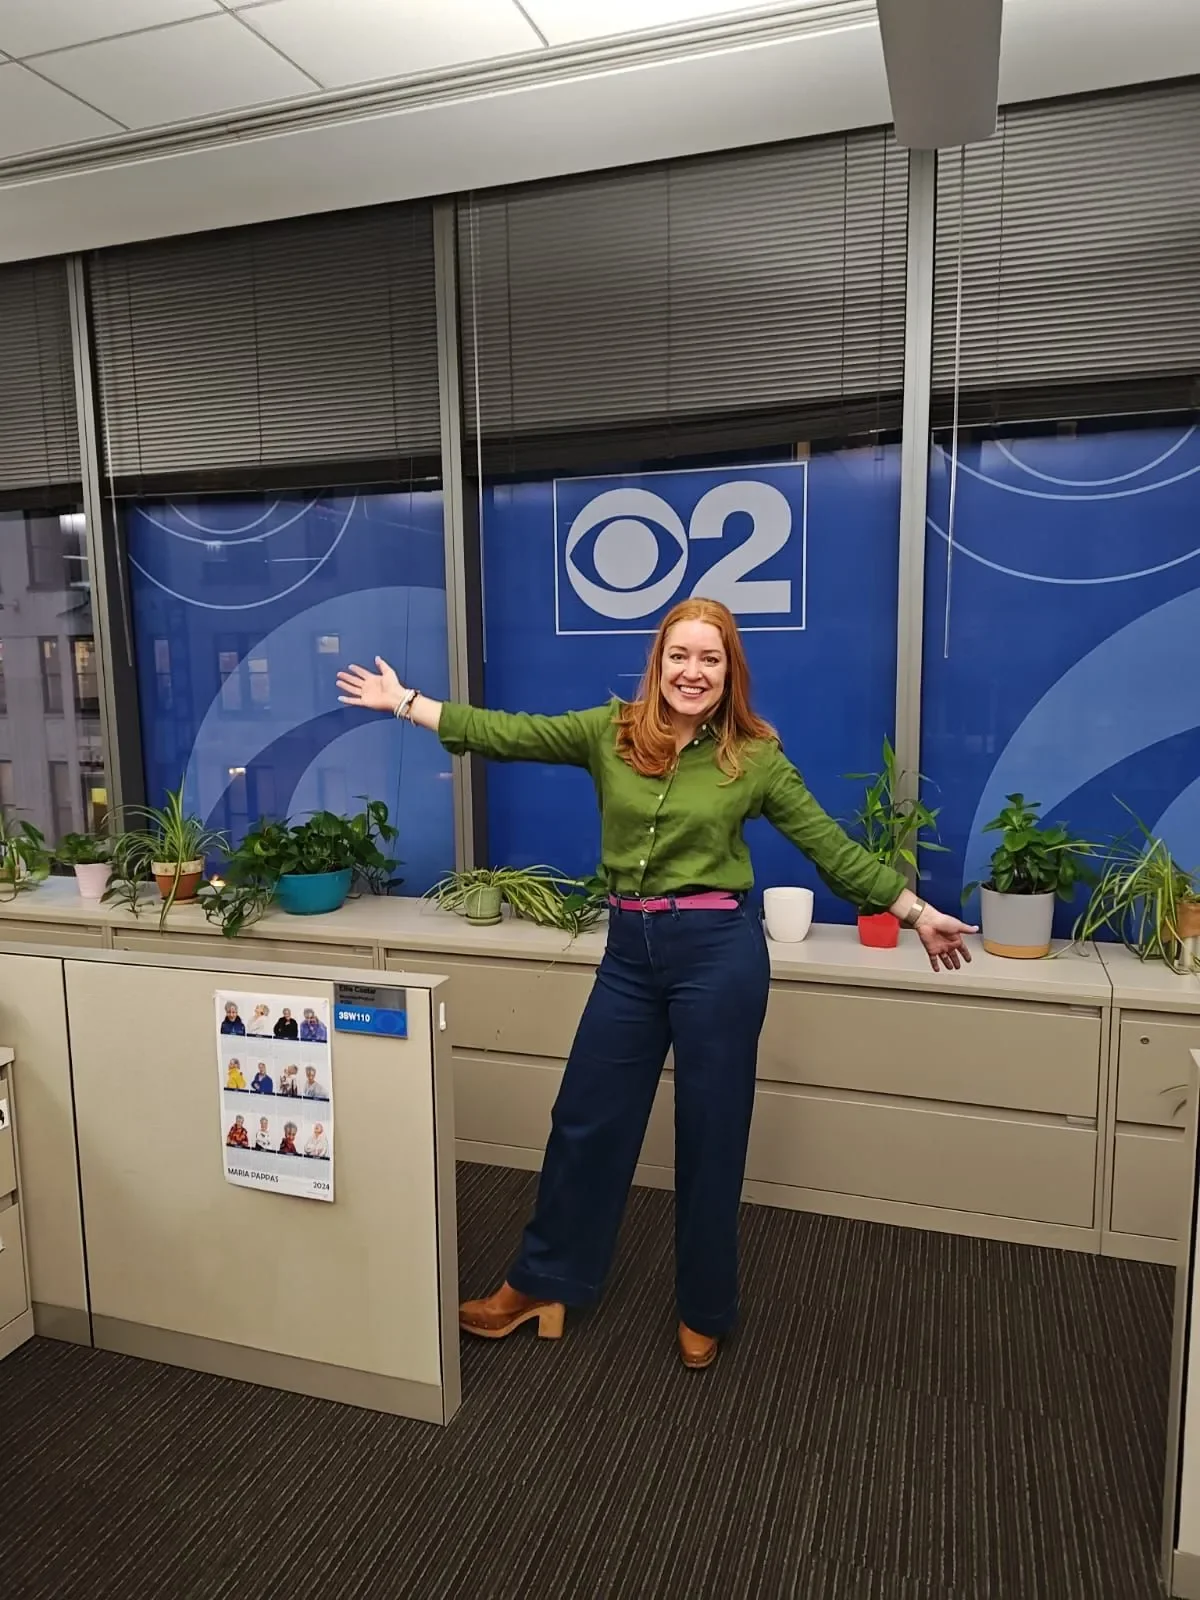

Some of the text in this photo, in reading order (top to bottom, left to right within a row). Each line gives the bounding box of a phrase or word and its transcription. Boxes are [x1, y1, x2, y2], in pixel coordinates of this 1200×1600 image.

[689, 480, 792, 614] 2
[228, 1168, 278, 1182] MARIA PAPPAS
[312, 1182, 330, 1191] 2024
